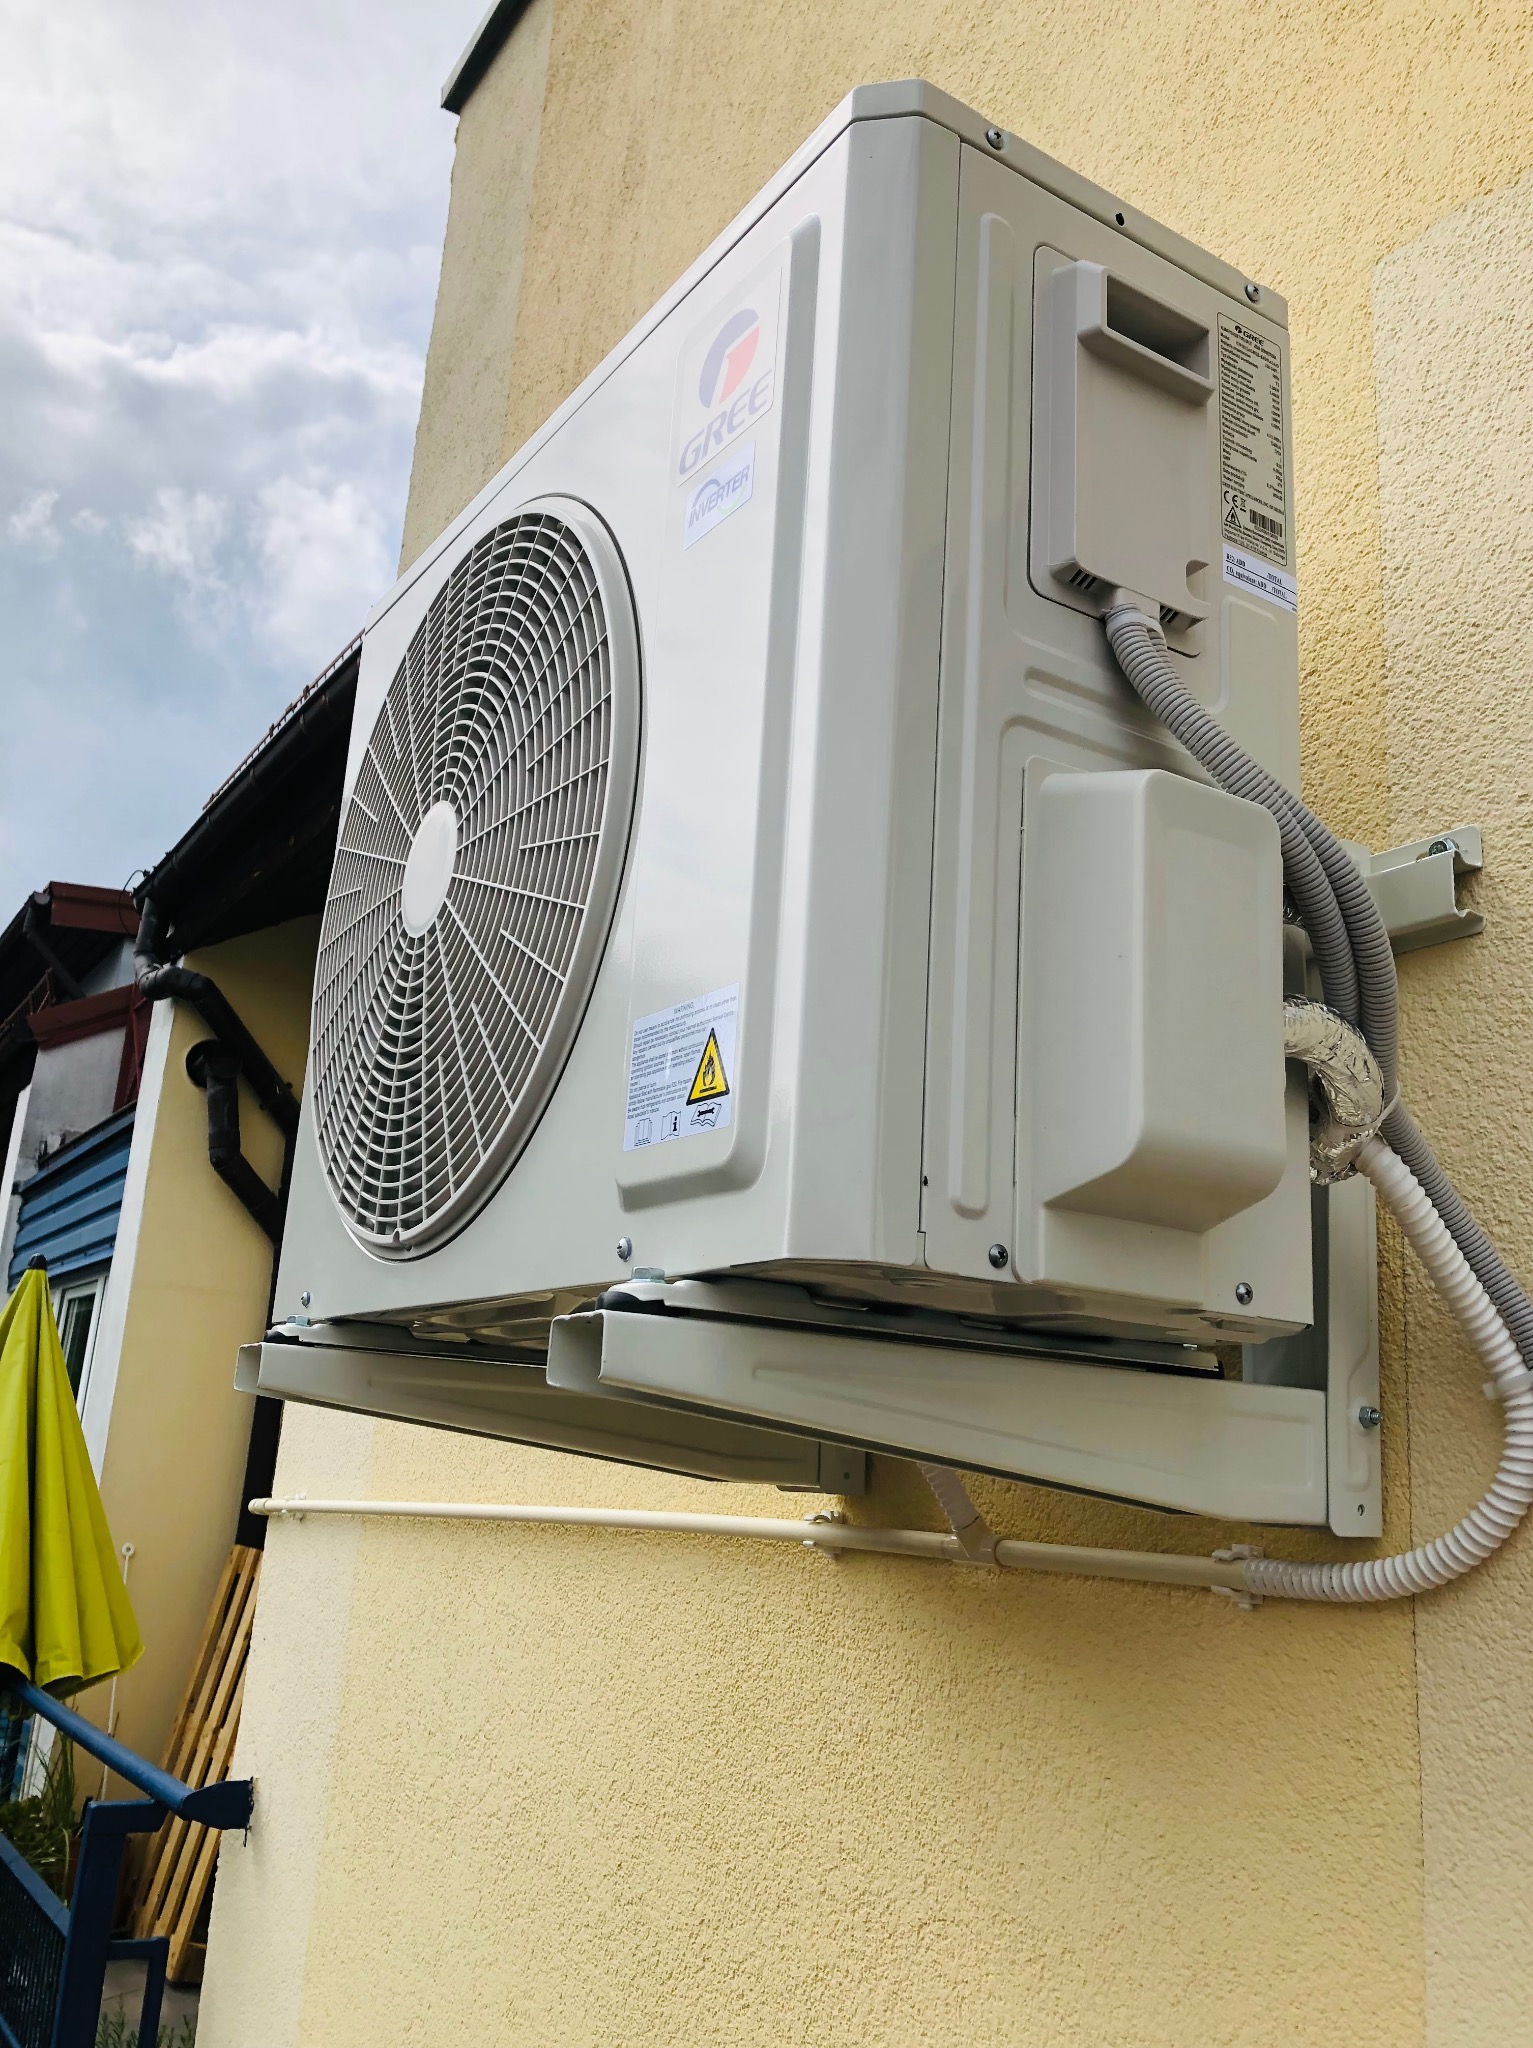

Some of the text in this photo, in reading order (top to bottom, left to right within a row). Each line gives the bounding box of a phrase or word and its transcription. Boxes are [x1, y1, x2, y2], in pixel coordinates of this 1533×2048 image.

[1243, 331, 1264, 347] GREE
[679, 368, 772, 476] GREE
[688, 464, 750, 529] INVERTER
